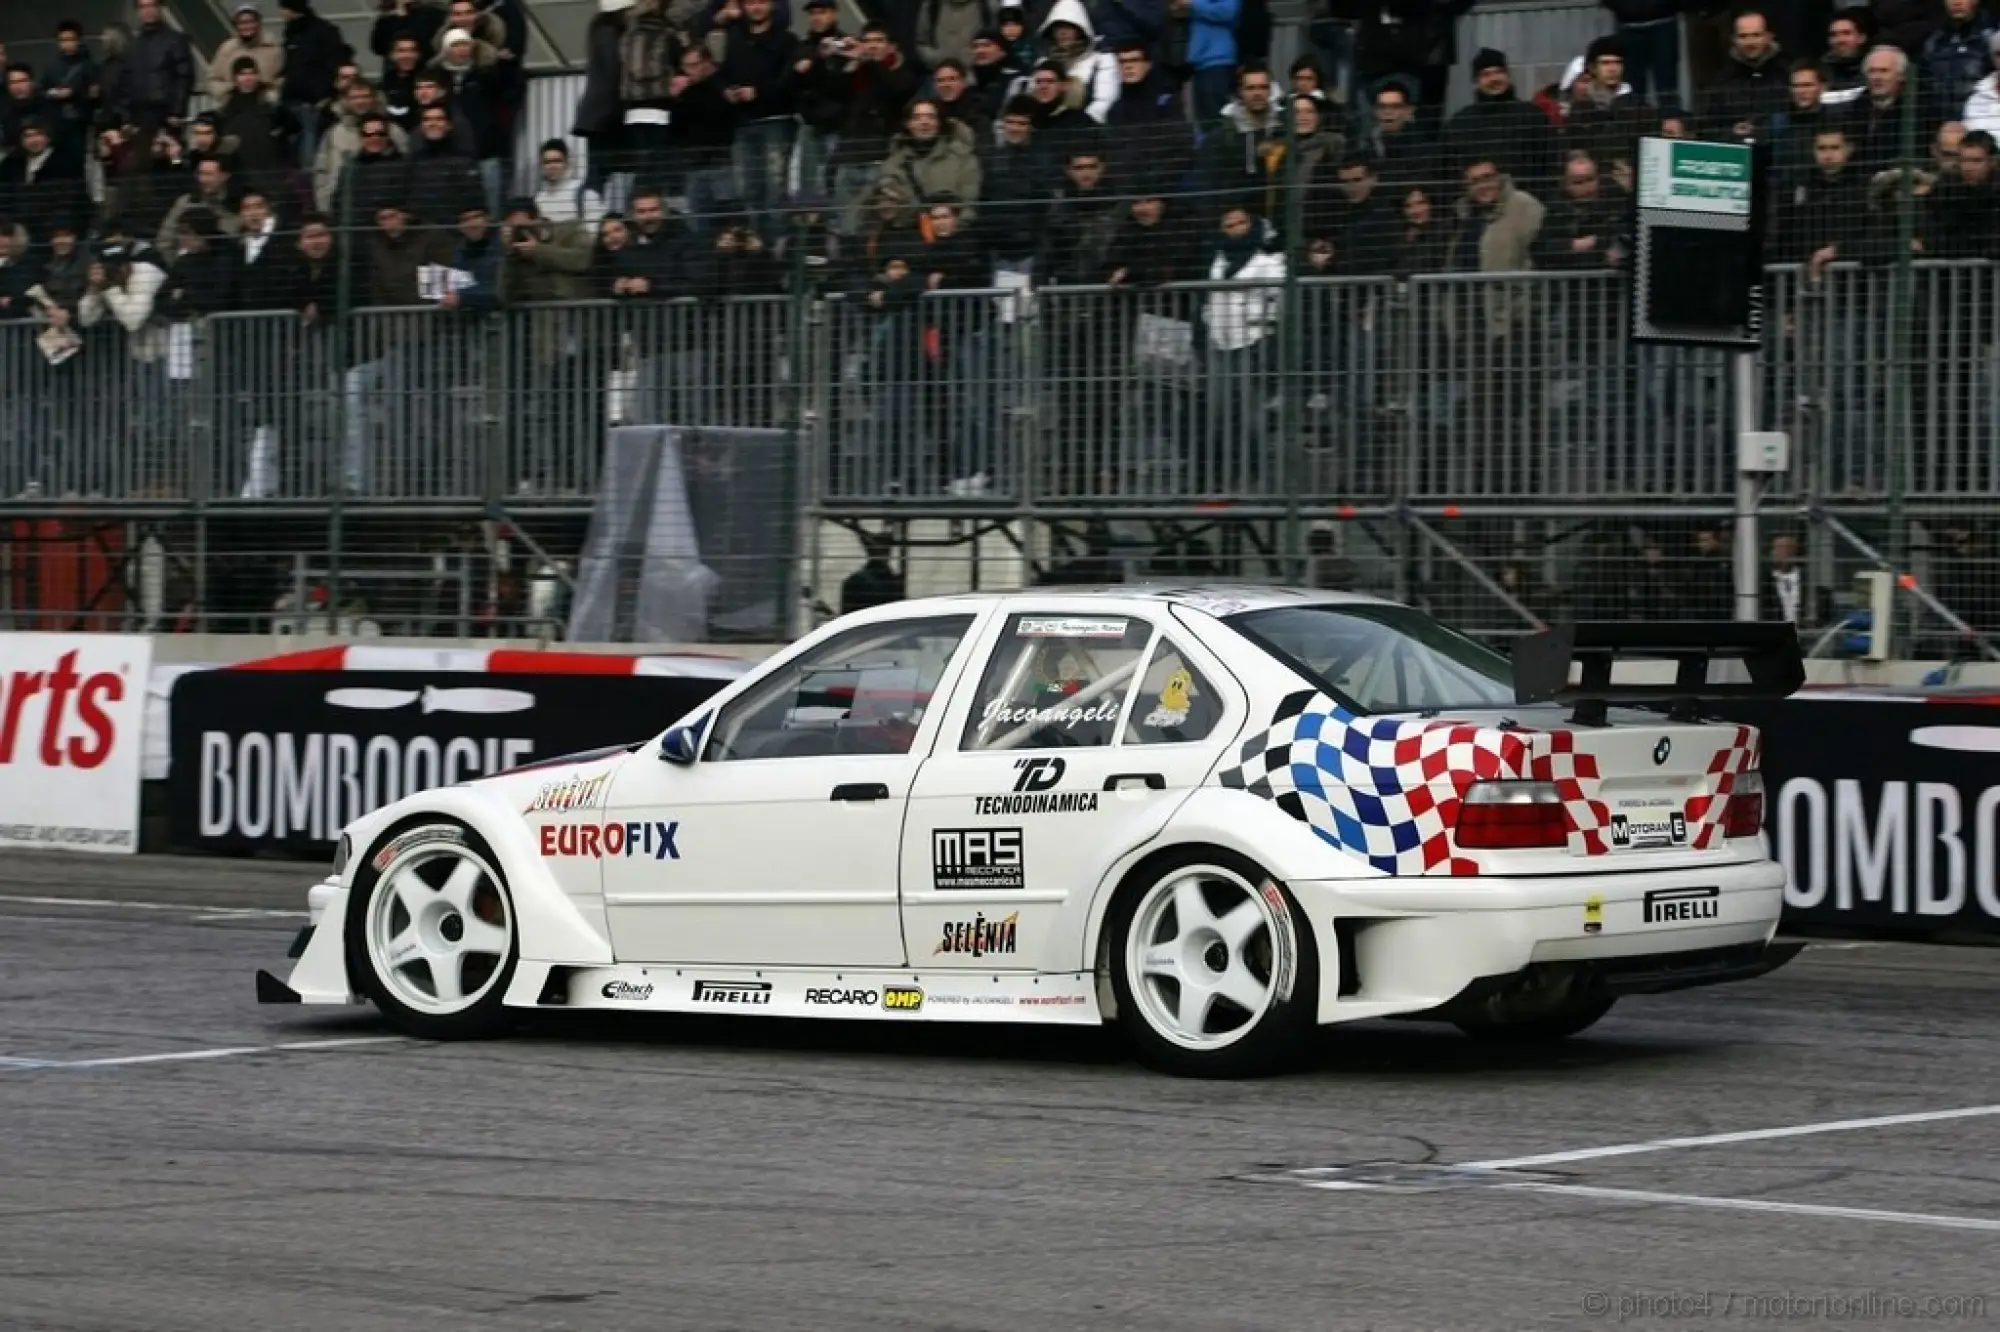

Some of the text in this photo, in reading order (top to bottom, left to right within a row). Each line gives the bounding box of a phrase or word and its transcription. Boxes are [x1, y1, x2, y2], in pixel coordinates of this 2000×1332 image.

[0, 647, 125, 769] rts
[978, 697, 1119, 731] Jacoangeli
[200, 731, 535, 841] BOMBOO
[975, 792, 1098, 815] TECNODINAMICA
[540, 821, 680, 860] EUROFIX
[934, 830, 1021, 870] MAS
[1643, 886, 1720, 923] PIRELLI
[692, 980, 773, 1005] PIRELLI
[804, 988, 878, 1005] RECARO
[885, 990, 921, 1006] OMP
